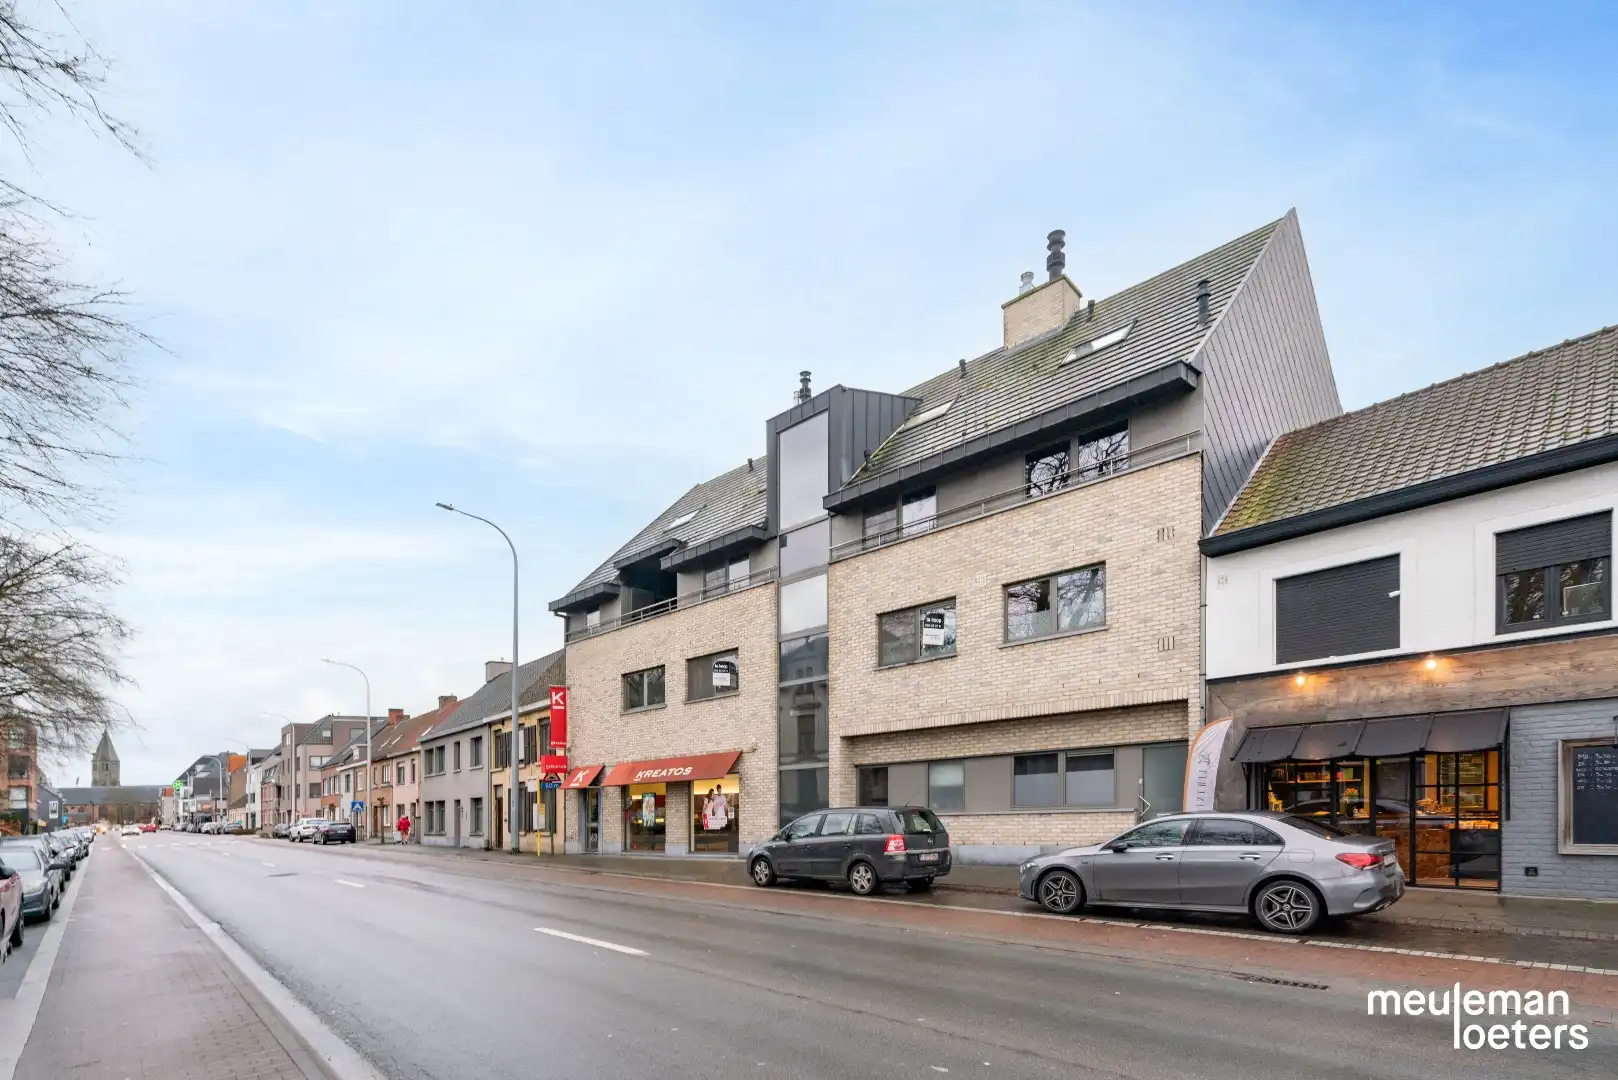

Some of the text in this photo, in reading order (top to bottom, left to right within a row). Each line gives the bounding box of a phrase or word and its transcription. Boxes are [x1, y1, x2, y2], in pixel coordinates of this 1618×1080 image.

[551, 691, 564, 705] K
[573, 769, 590, 782] K
[635, 766, 693, 779] KREATOS
